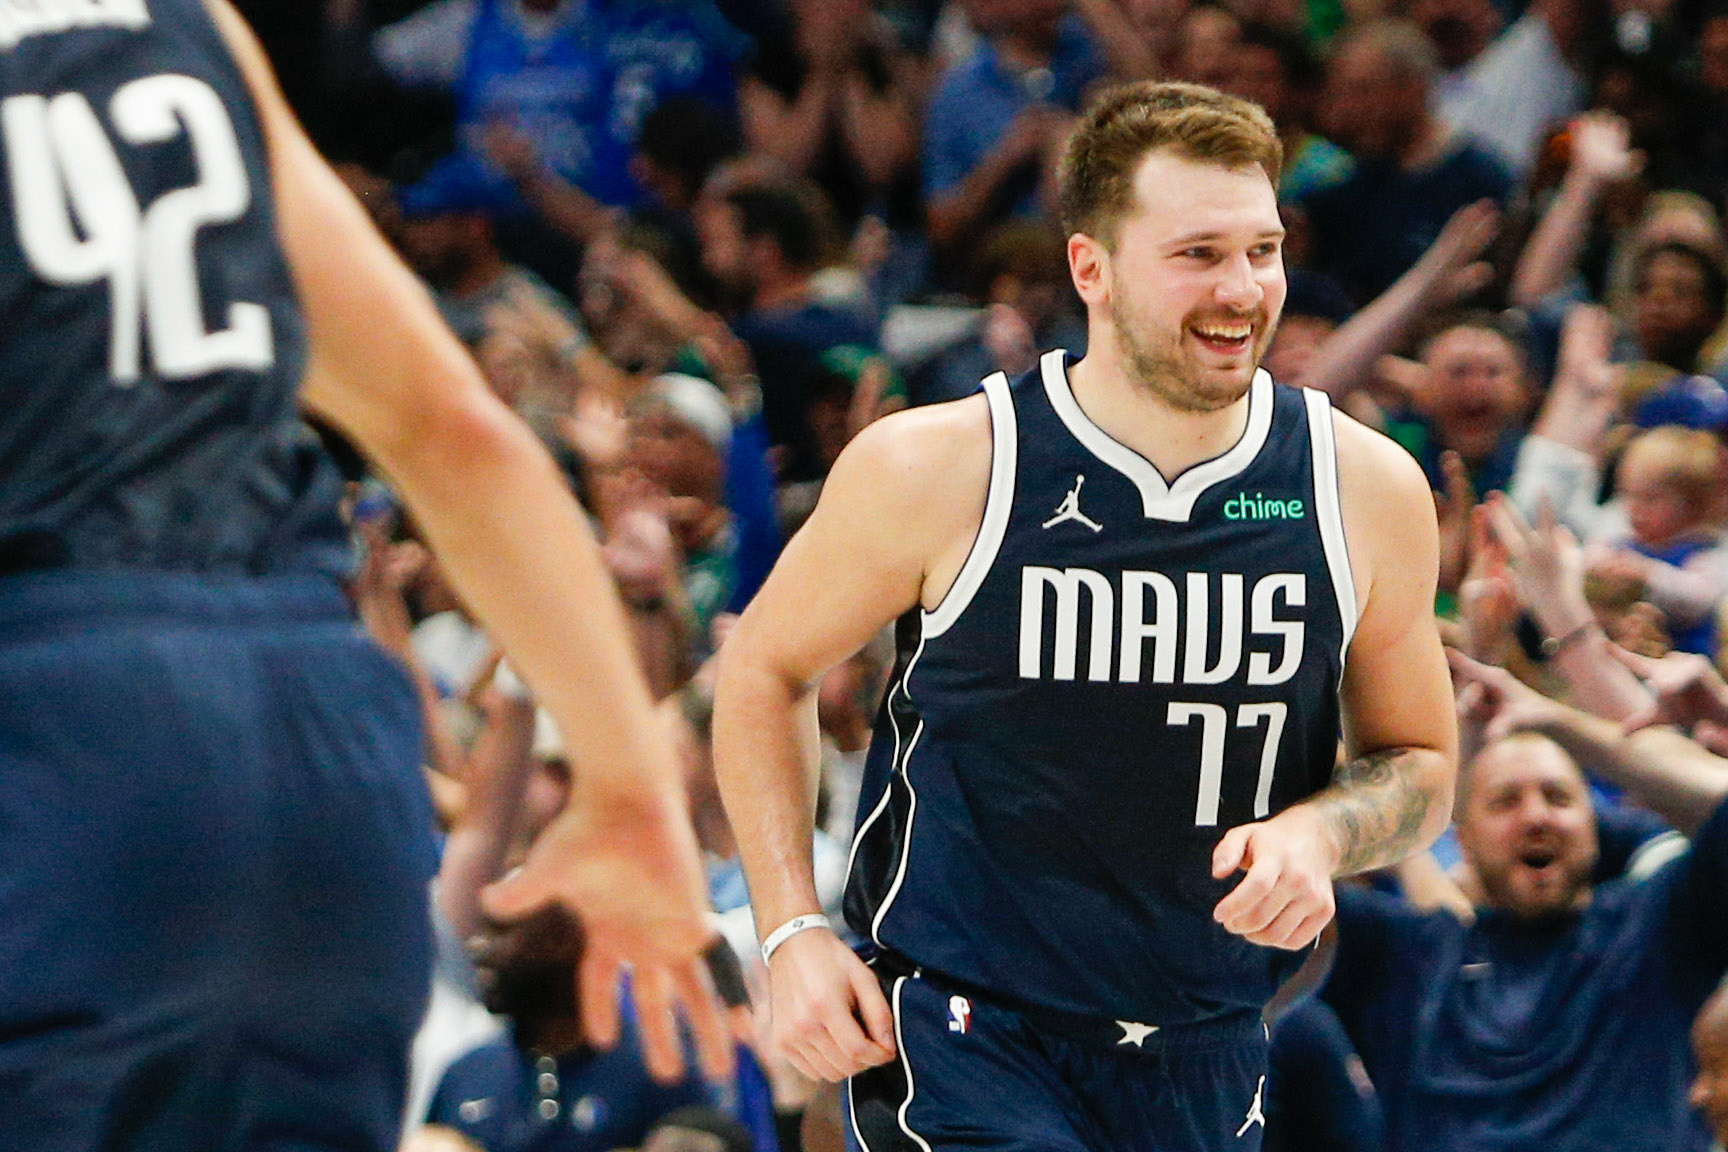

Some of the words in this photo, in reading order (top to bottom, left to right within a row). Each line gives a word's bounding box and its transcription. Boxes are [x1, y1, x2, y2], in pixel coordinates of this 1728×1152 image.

[2, 73, 276, 387] 42
[1223, 491, 1305, 519] chime
[1019, 565, 1307, 685] MAVS
[1166, 701, 1288, 827] 77
